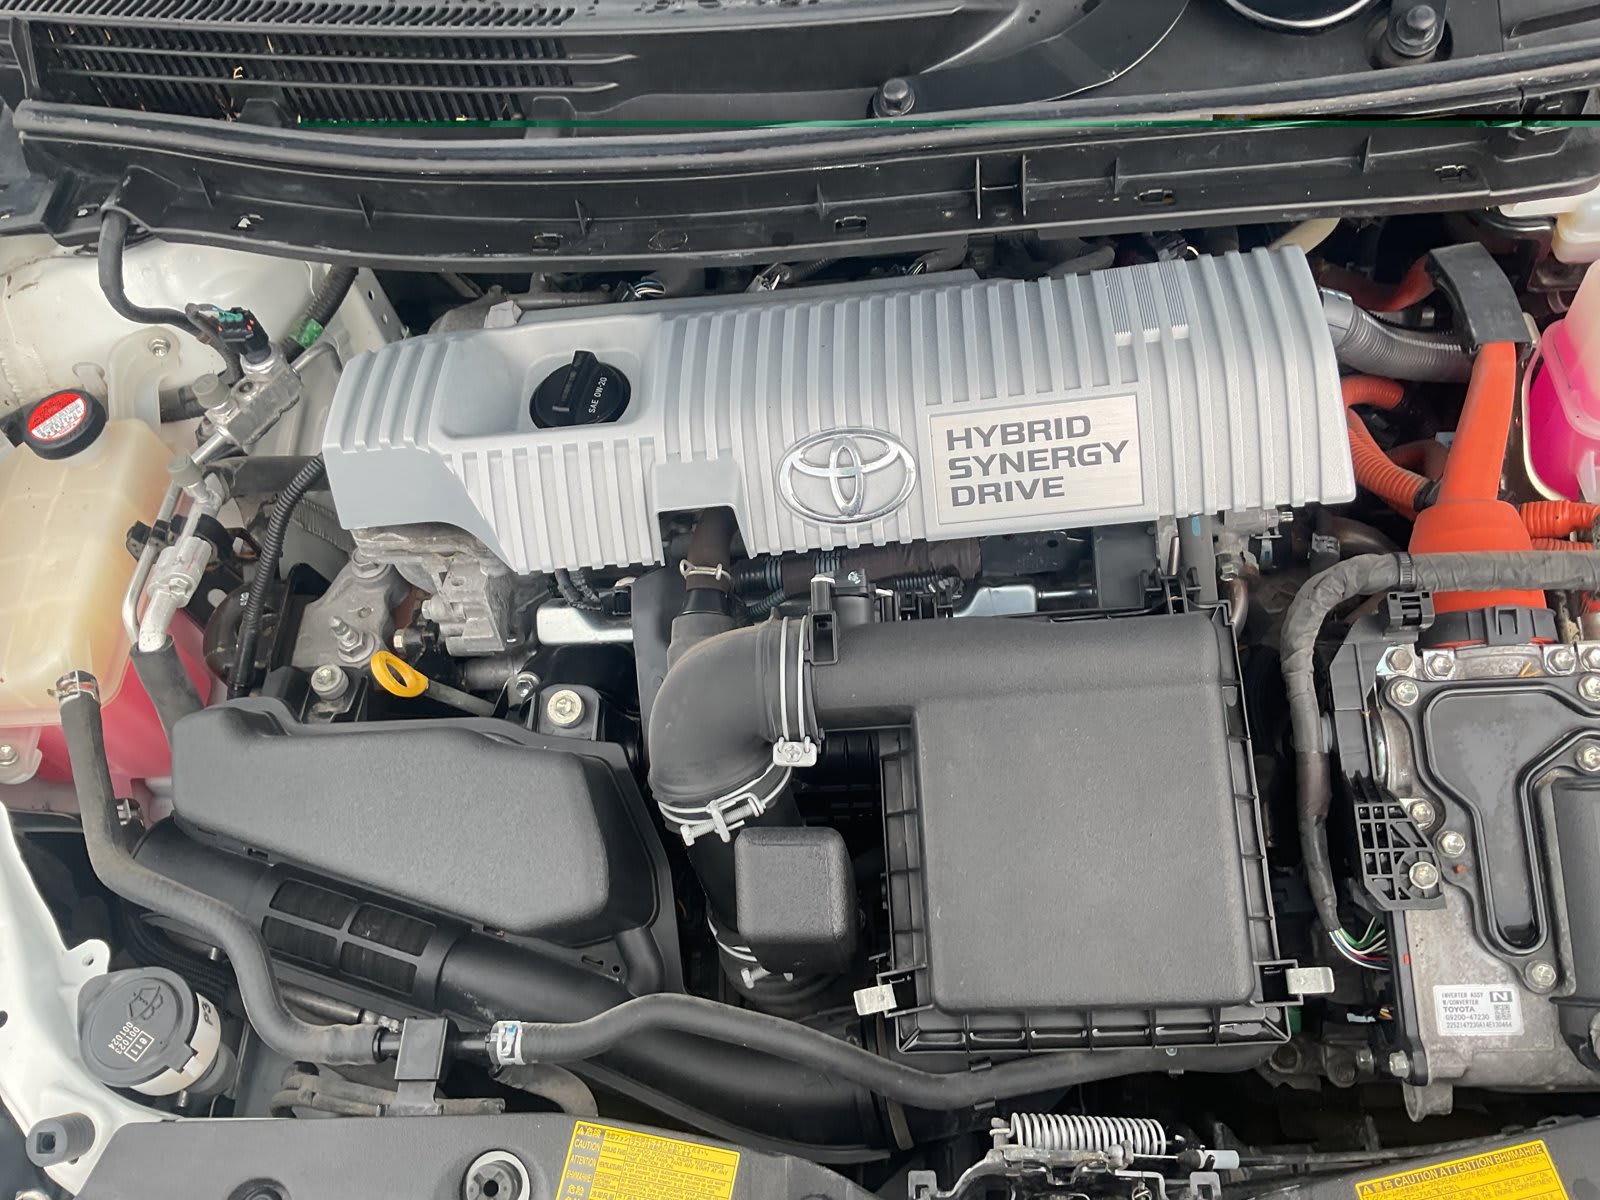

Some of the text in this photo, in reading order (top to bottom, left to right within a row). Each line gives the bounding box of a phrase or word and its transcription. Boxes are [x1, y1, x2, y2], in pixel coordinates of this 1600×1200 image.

[588, 376, 608, 413] SAE 0W-20
[946, 415, 1091, 451] HYBRID
[948, 440, 1130, 480] SYNERGY
[950, 475, 1066, 507] DRIVE
[108, 1021, 134, 1050] 001024
[114, 1026, 140, 1055] 001023
[570, 1154, 596, 1167] ATTENTION
[574, 1138, 600, 1151] CAUTION
[1394, 1168, 1438, 1187] CAUTION
[1440, 1155, 1494, 1177] ATTENTION
